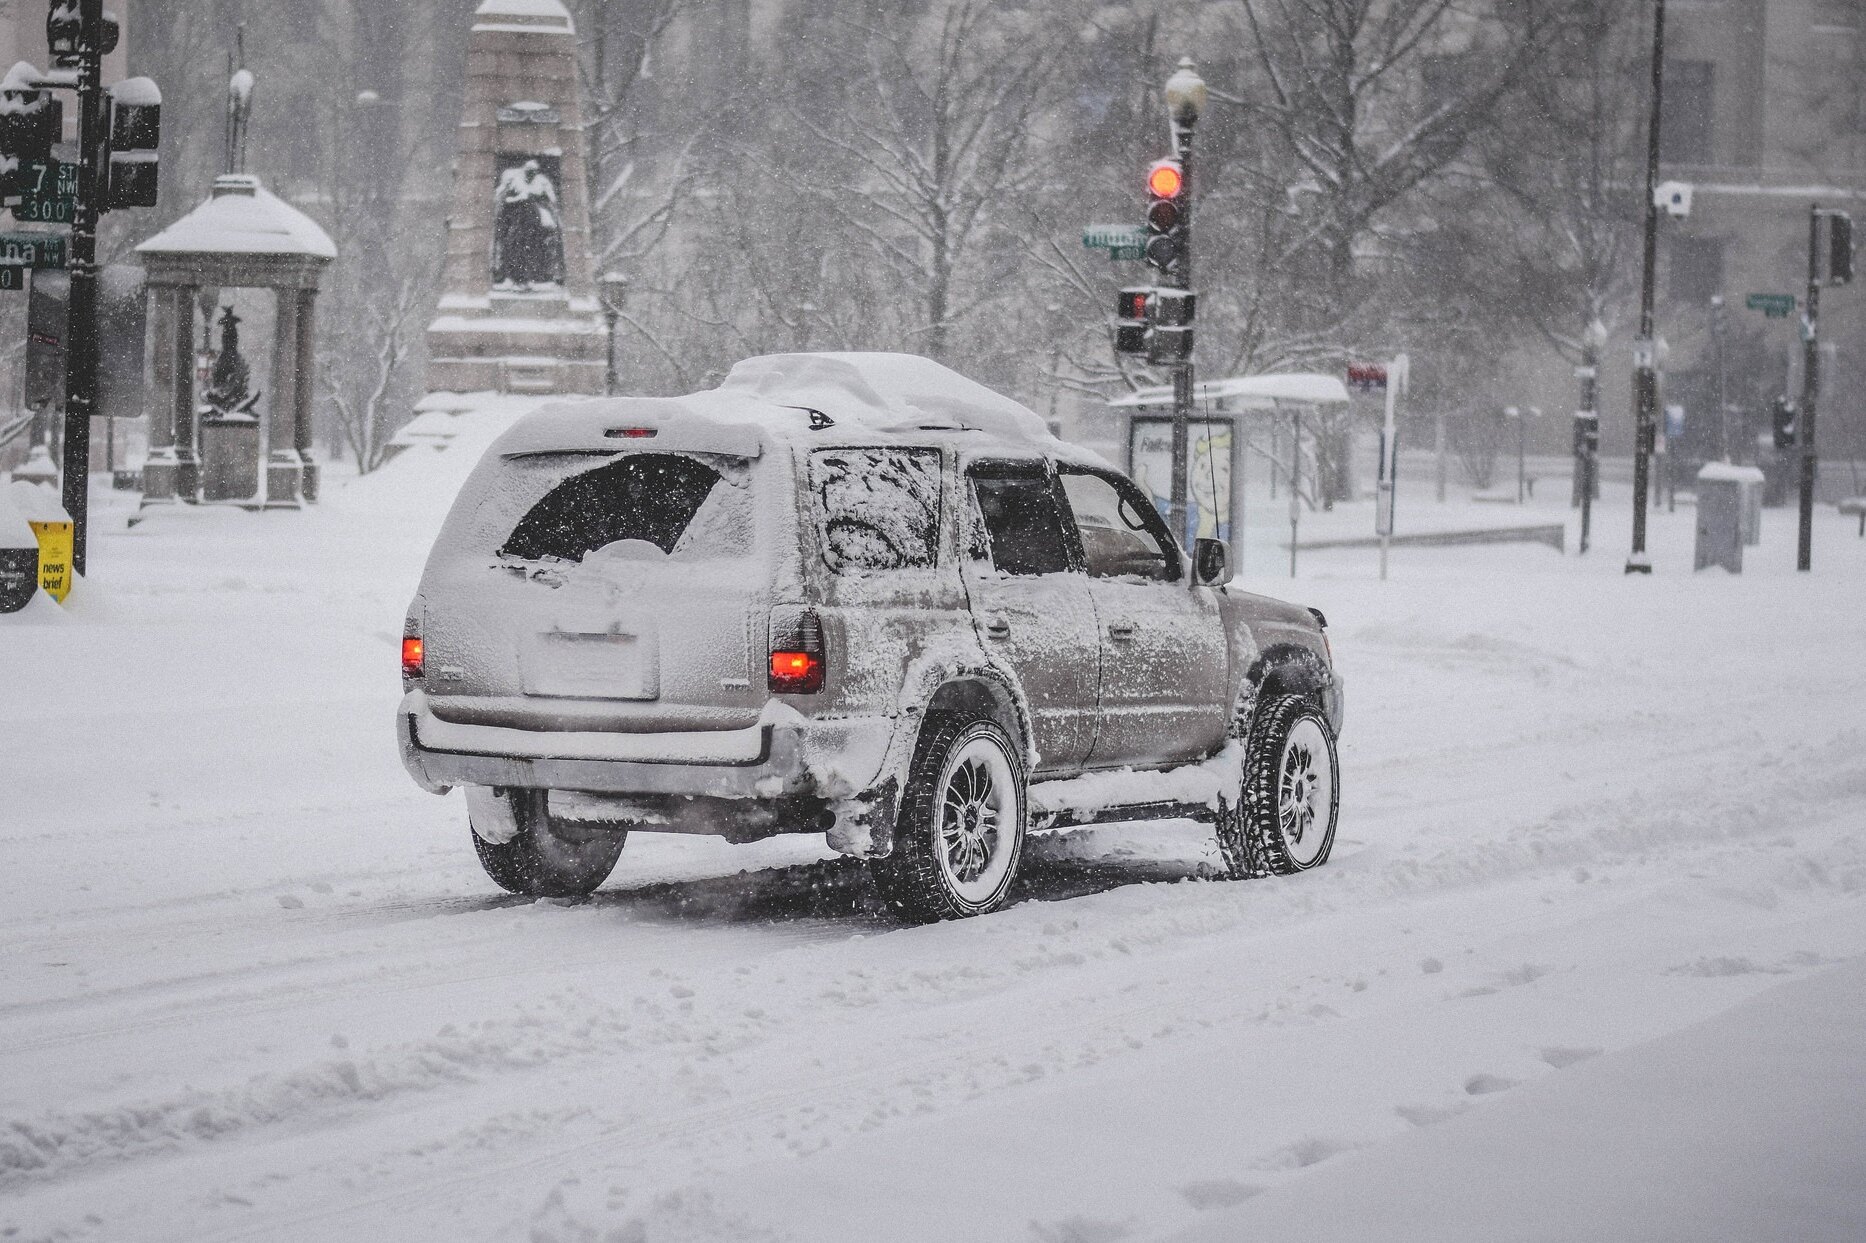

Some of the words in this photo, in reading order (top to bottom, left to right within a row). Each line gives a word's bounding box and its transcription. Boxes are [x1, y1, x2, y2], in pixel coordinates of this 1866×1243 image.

[32, 164, 47, 192] 7
[59, 165, 74, 179] ST
[57, 179, 78, 194] NW
[30, 200, 65, 219] 300
[43, 563, 65, 573] news
[43, 576, 63, 590] brief
